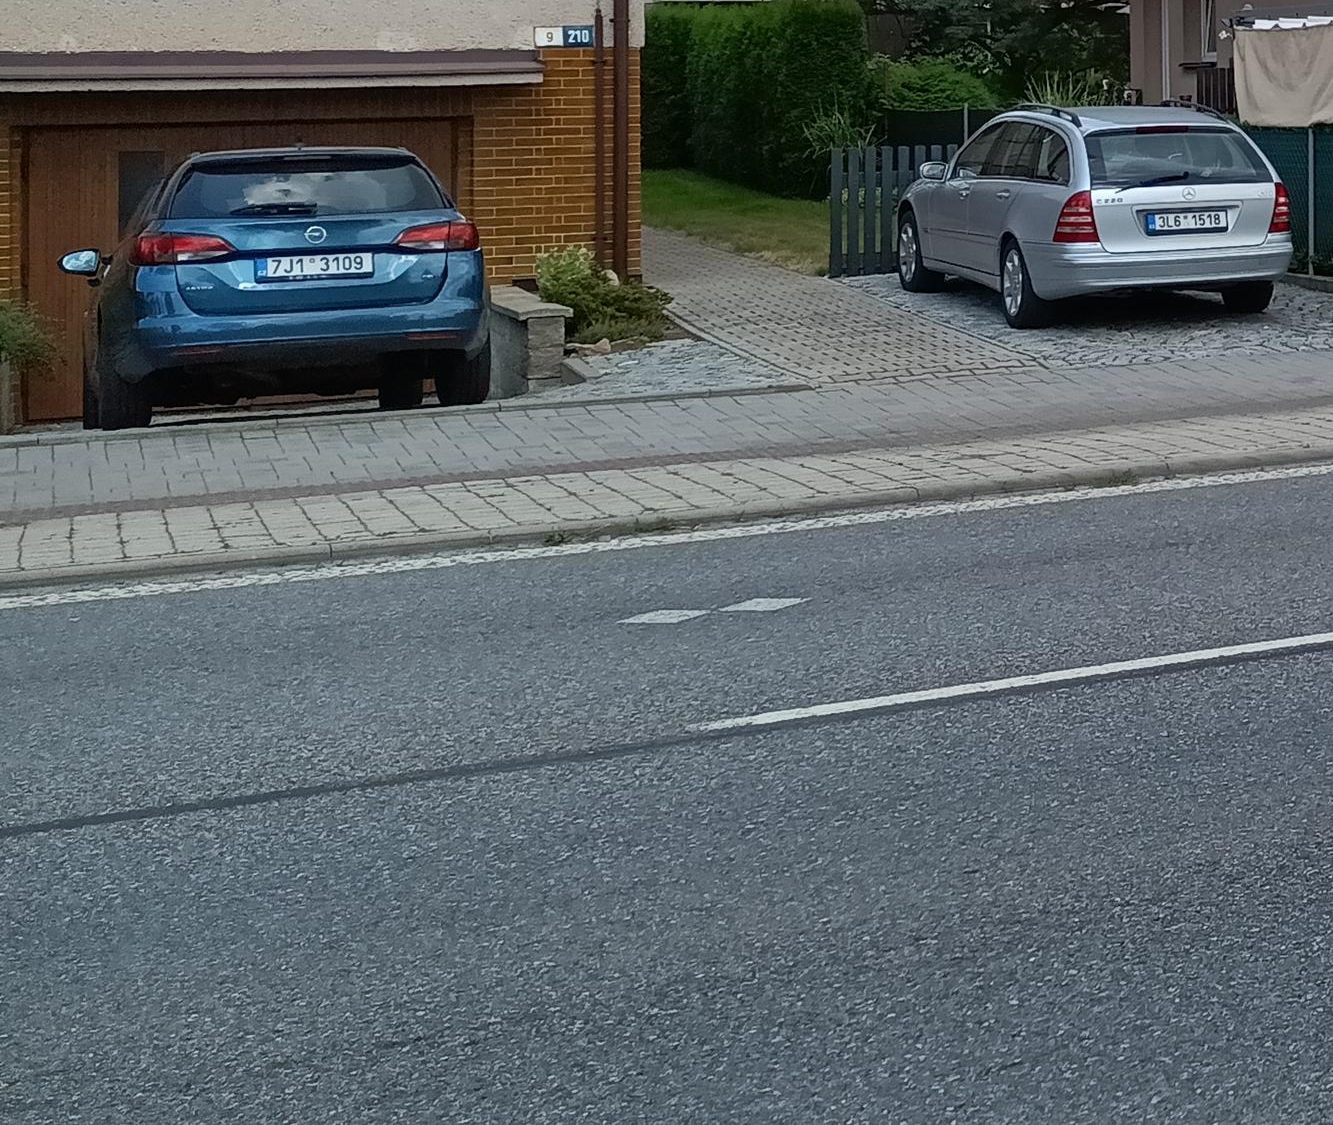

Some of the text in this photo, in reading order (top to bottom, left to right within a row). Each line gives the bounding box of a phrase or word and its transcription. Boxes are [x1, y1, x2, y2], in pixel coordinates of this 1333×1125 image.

[546, 32, 553, 43] 9
[567, 30, 590, 43] 210
[1158, 213, 1221, 228] 3L6 1518
[271, 255, 363, 275] 7J1 3109
